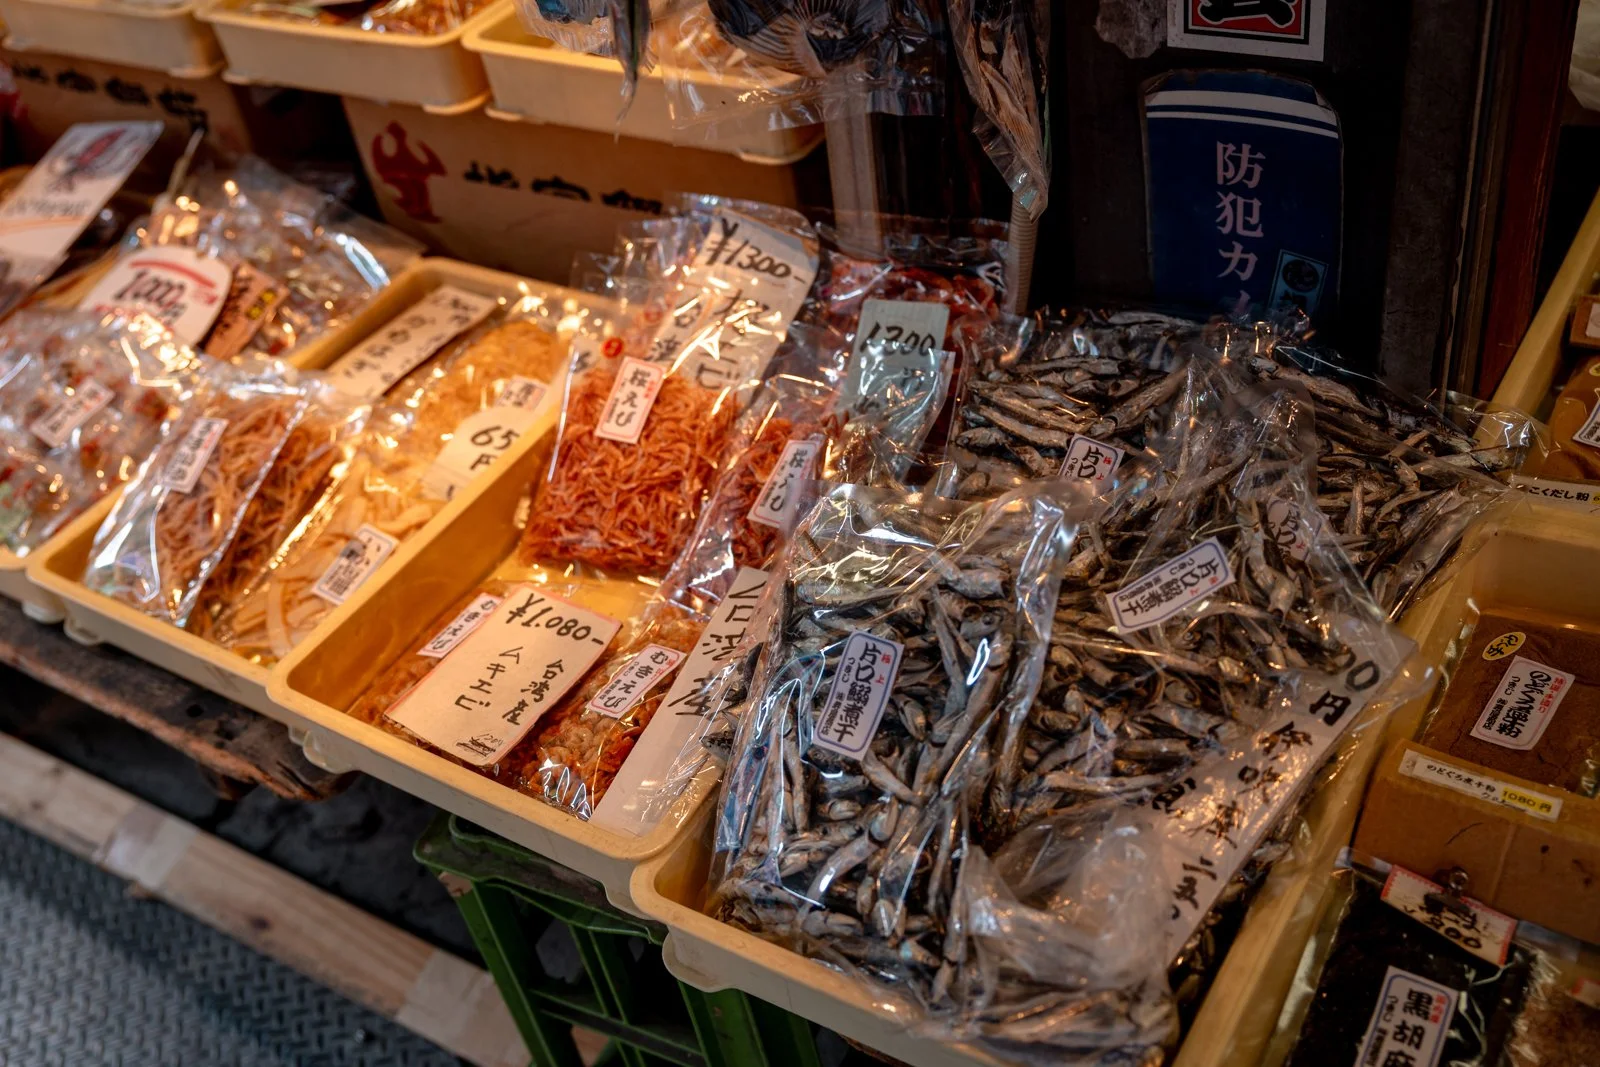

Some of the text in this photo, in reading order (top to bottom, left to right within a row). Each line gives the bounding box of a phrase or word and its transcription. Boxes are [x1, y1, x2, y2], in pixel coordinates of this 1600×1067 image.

[454, 646, 524, 711] ムキエビ
[502, 659, 565, 726] 台湾産
[603, 650, 669, 709] むきえび
[1309, 690, 1352, 727] 円
